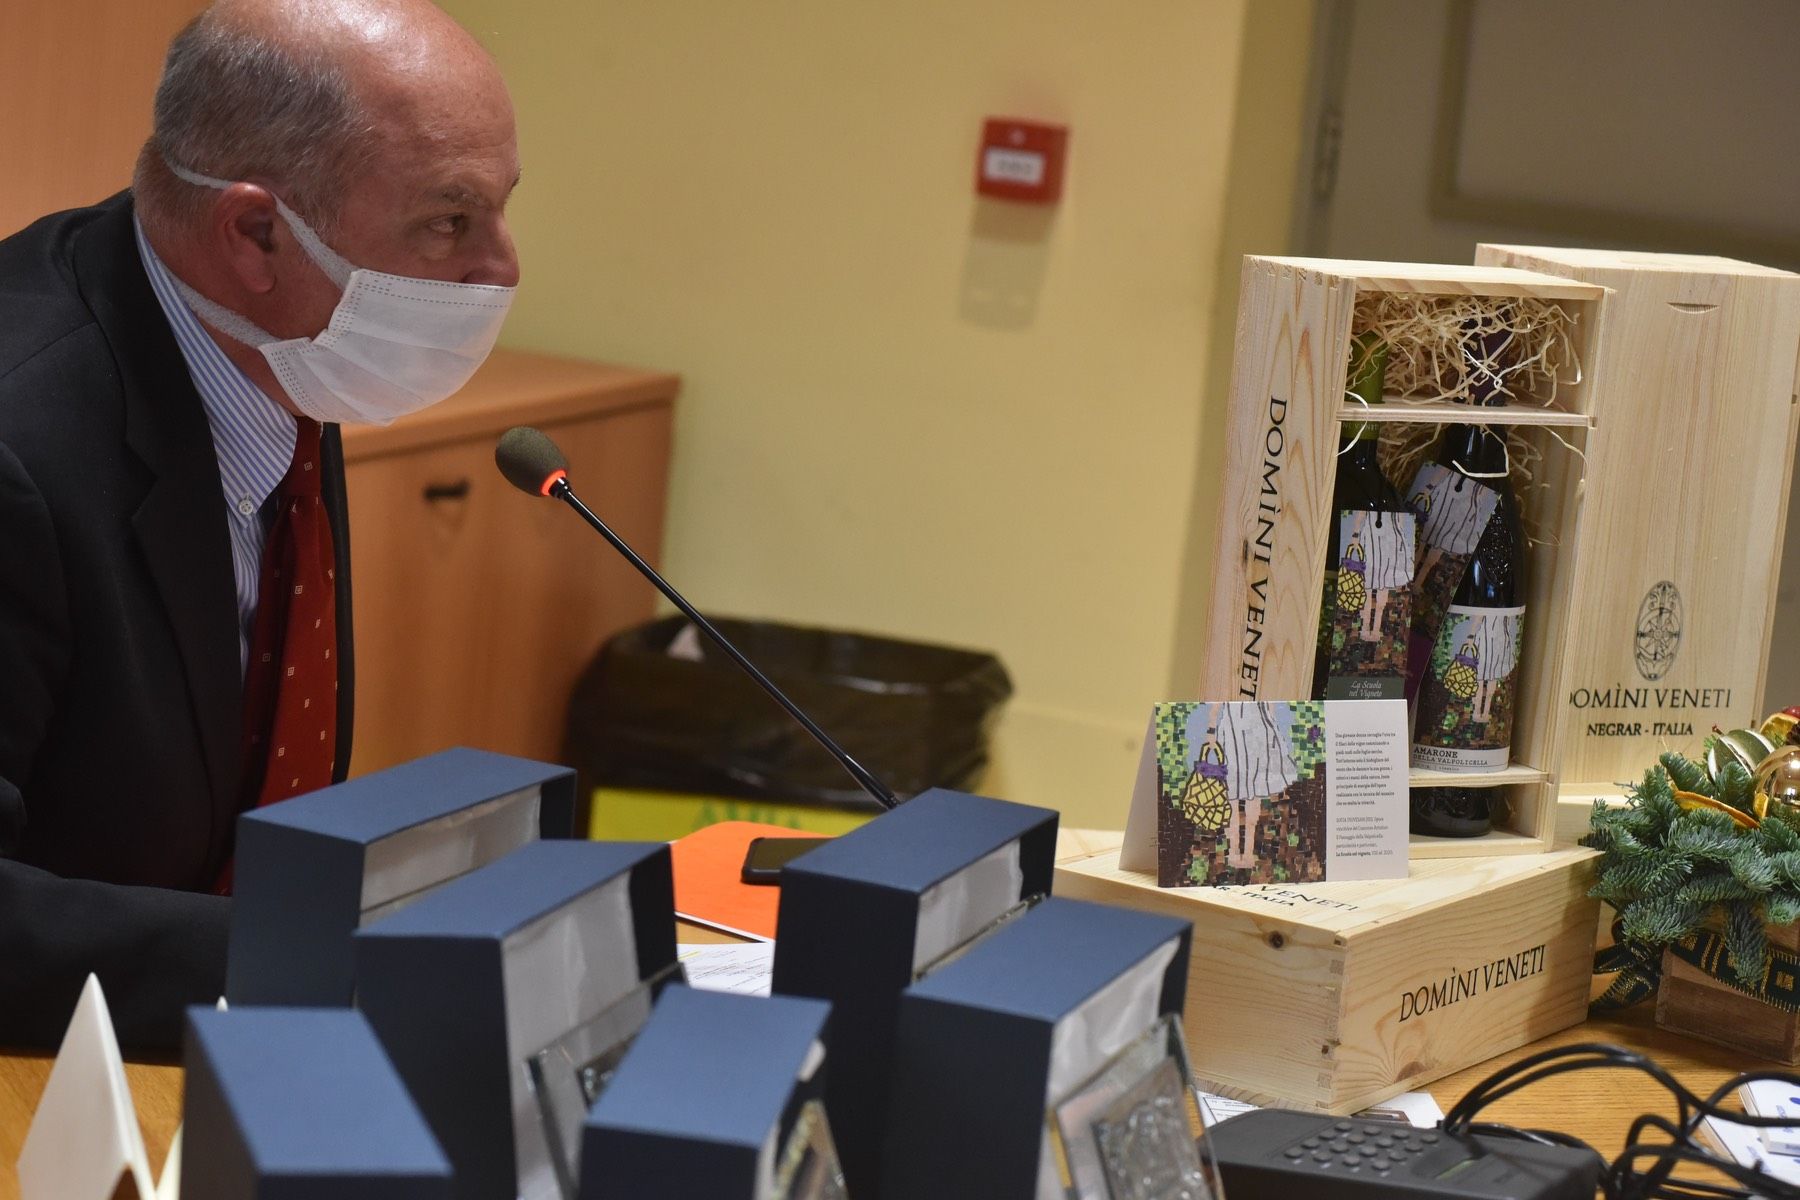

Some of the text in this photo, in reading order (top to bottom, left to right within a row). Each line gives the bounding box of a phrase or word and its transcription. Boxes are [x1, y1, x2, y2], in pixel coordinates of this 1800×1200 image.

[1240, 396, 1287, 701] DOMÌNI VENET
[1361, 680, 1382, 689] Scuola
[1360, 689, 1383, 698] Vigneto
[1569, 683, 1731, 708] OMÌNI VENETI
[1586, 723, 1642, 736] NEGRAR
[1652, 723, 1693, 735] ITALIA
[1413, 754, 1436, 762] DELLA
[1414, 746, 1458, 758] AMARONE
[1243, 892, 1295, 906] ITALIA
[1260, 885, 1359, 911] VENETI
[1399, 944, 1546, 1023] DOMÌNI VENETI
